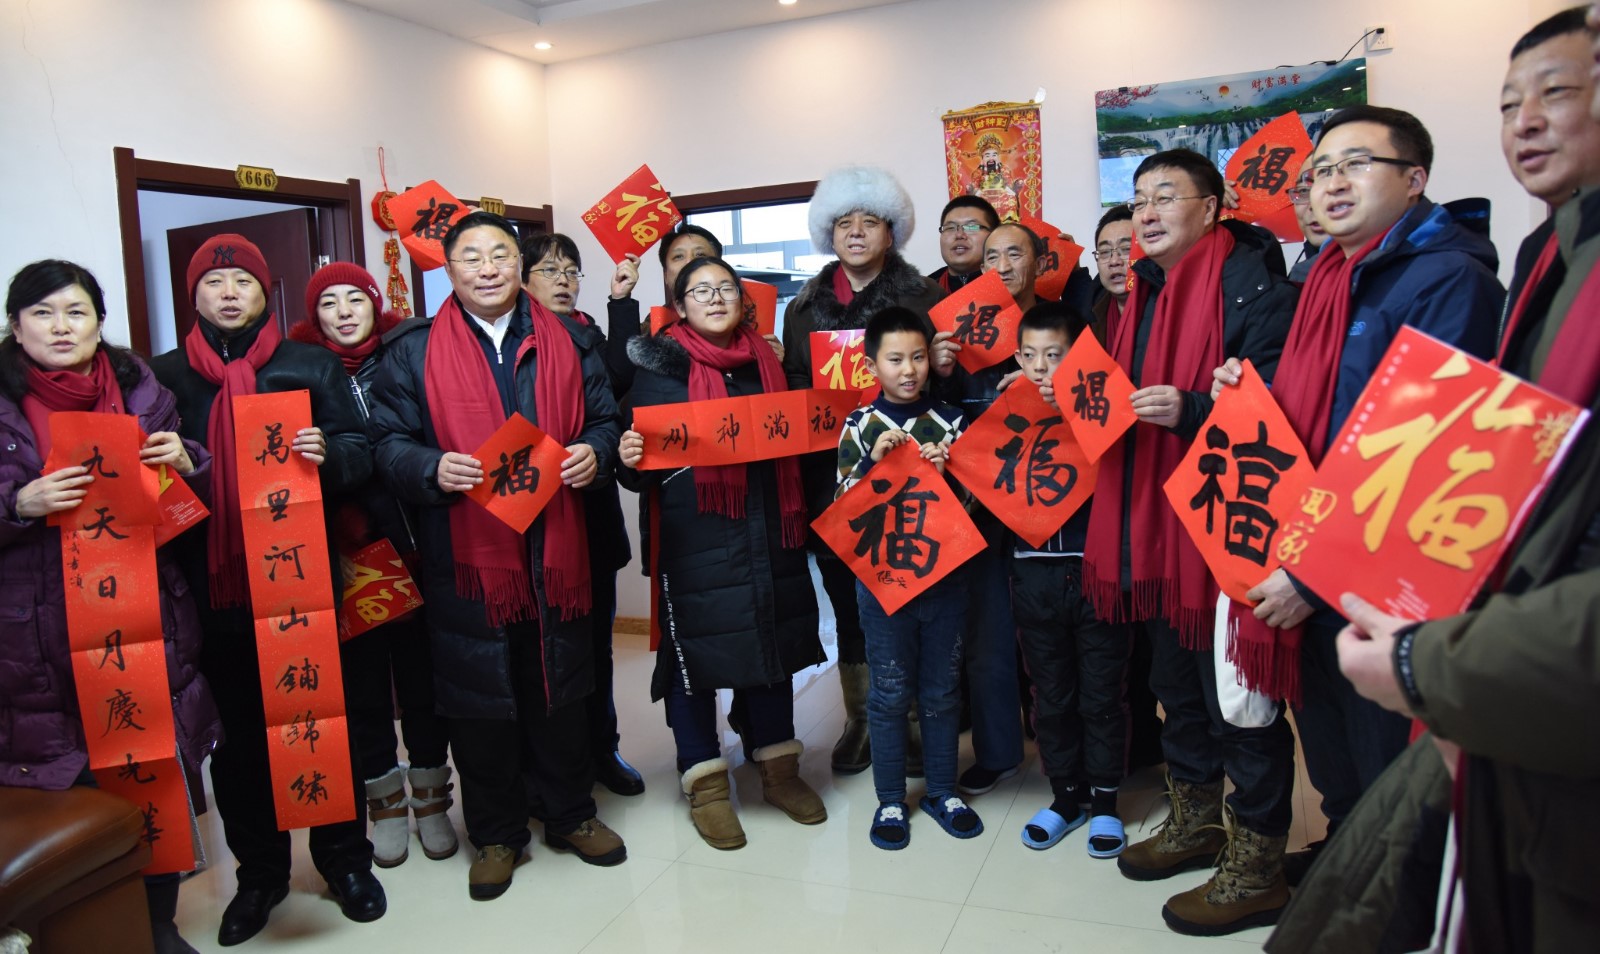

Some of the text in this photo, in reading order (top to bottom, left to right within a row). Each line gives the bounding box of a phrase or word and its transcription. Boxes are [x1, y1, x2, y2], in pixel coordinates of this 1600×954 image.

[245, 172, 272, 187] 666
[1236, 144, 1296, 196] 福
[411, 197, 459, 240] 福
[484, 200, 501, 213] 777
[211, 244, 237, 265] NY
[953, 301, 1002, 350] 福
[1071, 368, 1110, 427] 福
[489, 444, 540, 496] 福
[993, 413, 1078, 507] 福
[1190, 420, 1298, 567] 福
[848, 476, 940, 578] 福
